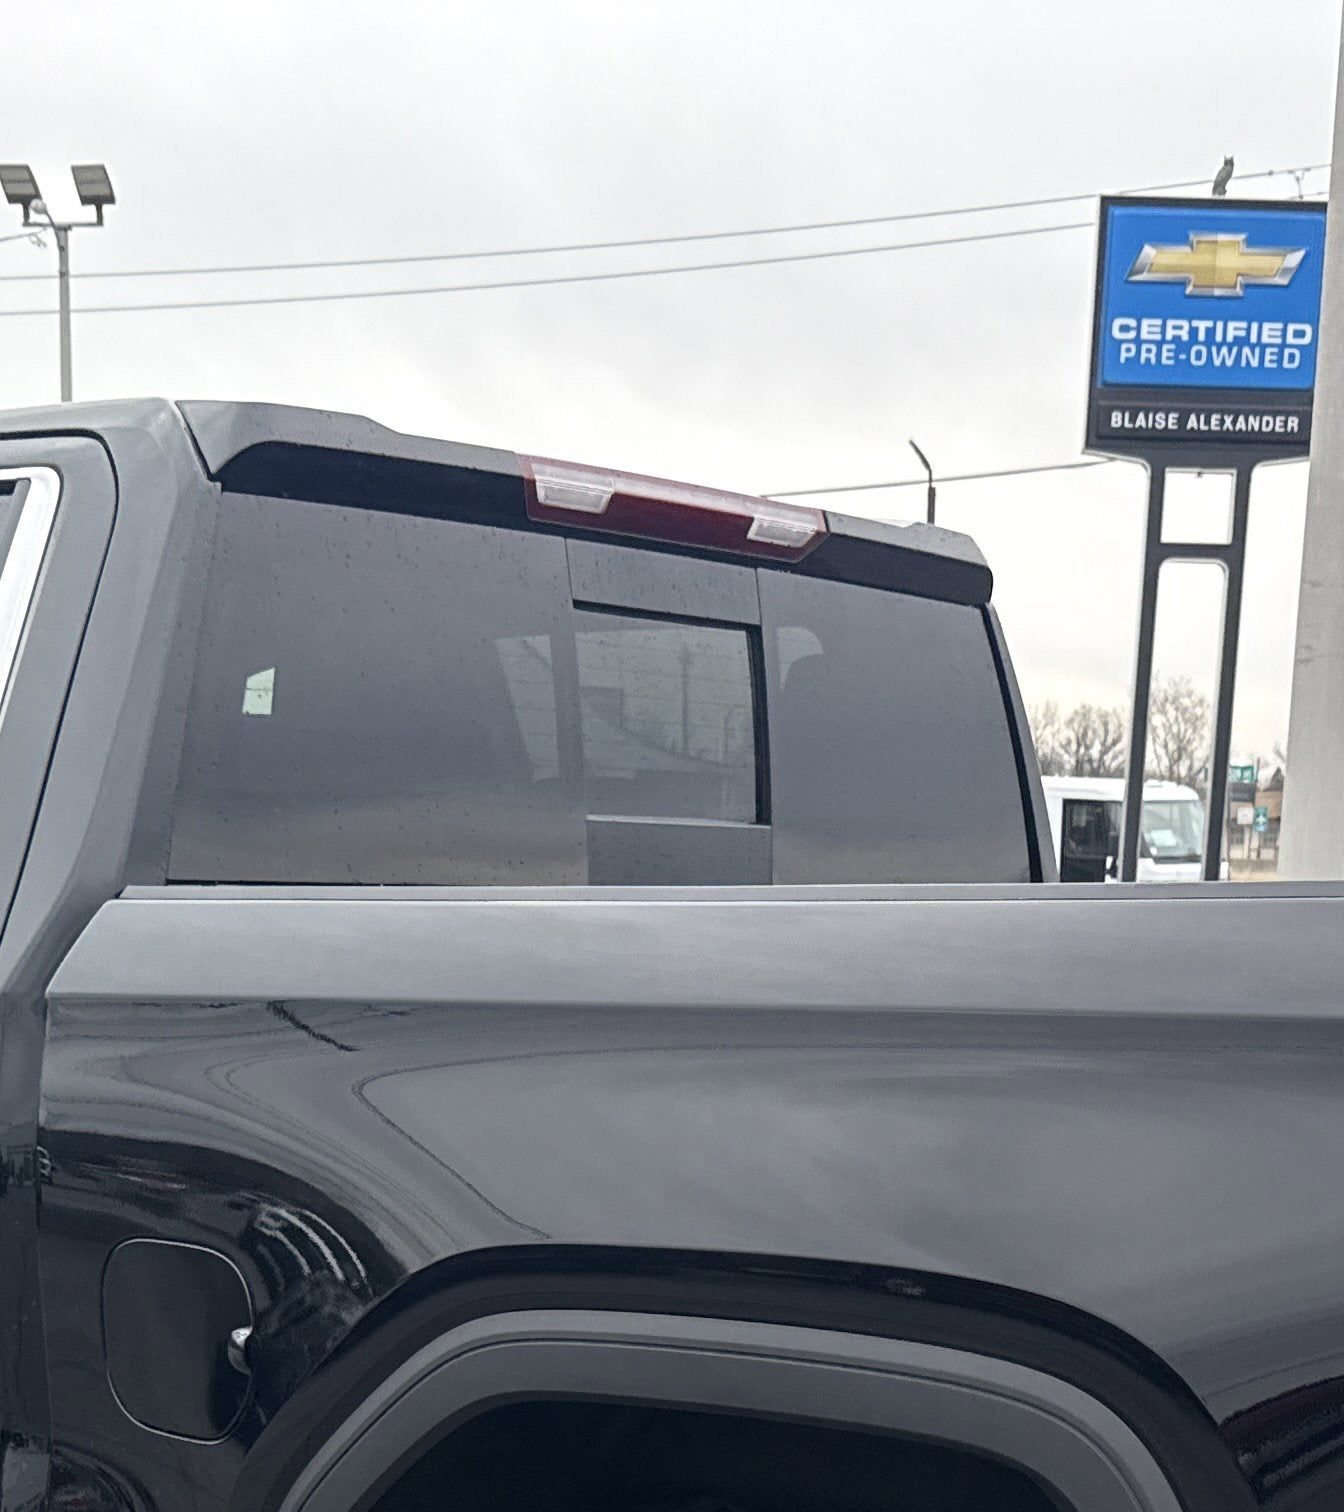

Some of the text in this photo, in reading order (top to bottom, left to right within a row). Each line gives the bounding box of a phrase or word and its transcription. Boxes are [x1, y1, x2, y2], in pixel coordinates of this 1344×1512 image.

[1111, 317, 1313, 345] CERTIFIED
[1119, 343, 1301, 369] PRE-OWNED
[1110, 411, 1299, 433] BLAISE ALEXANDER
